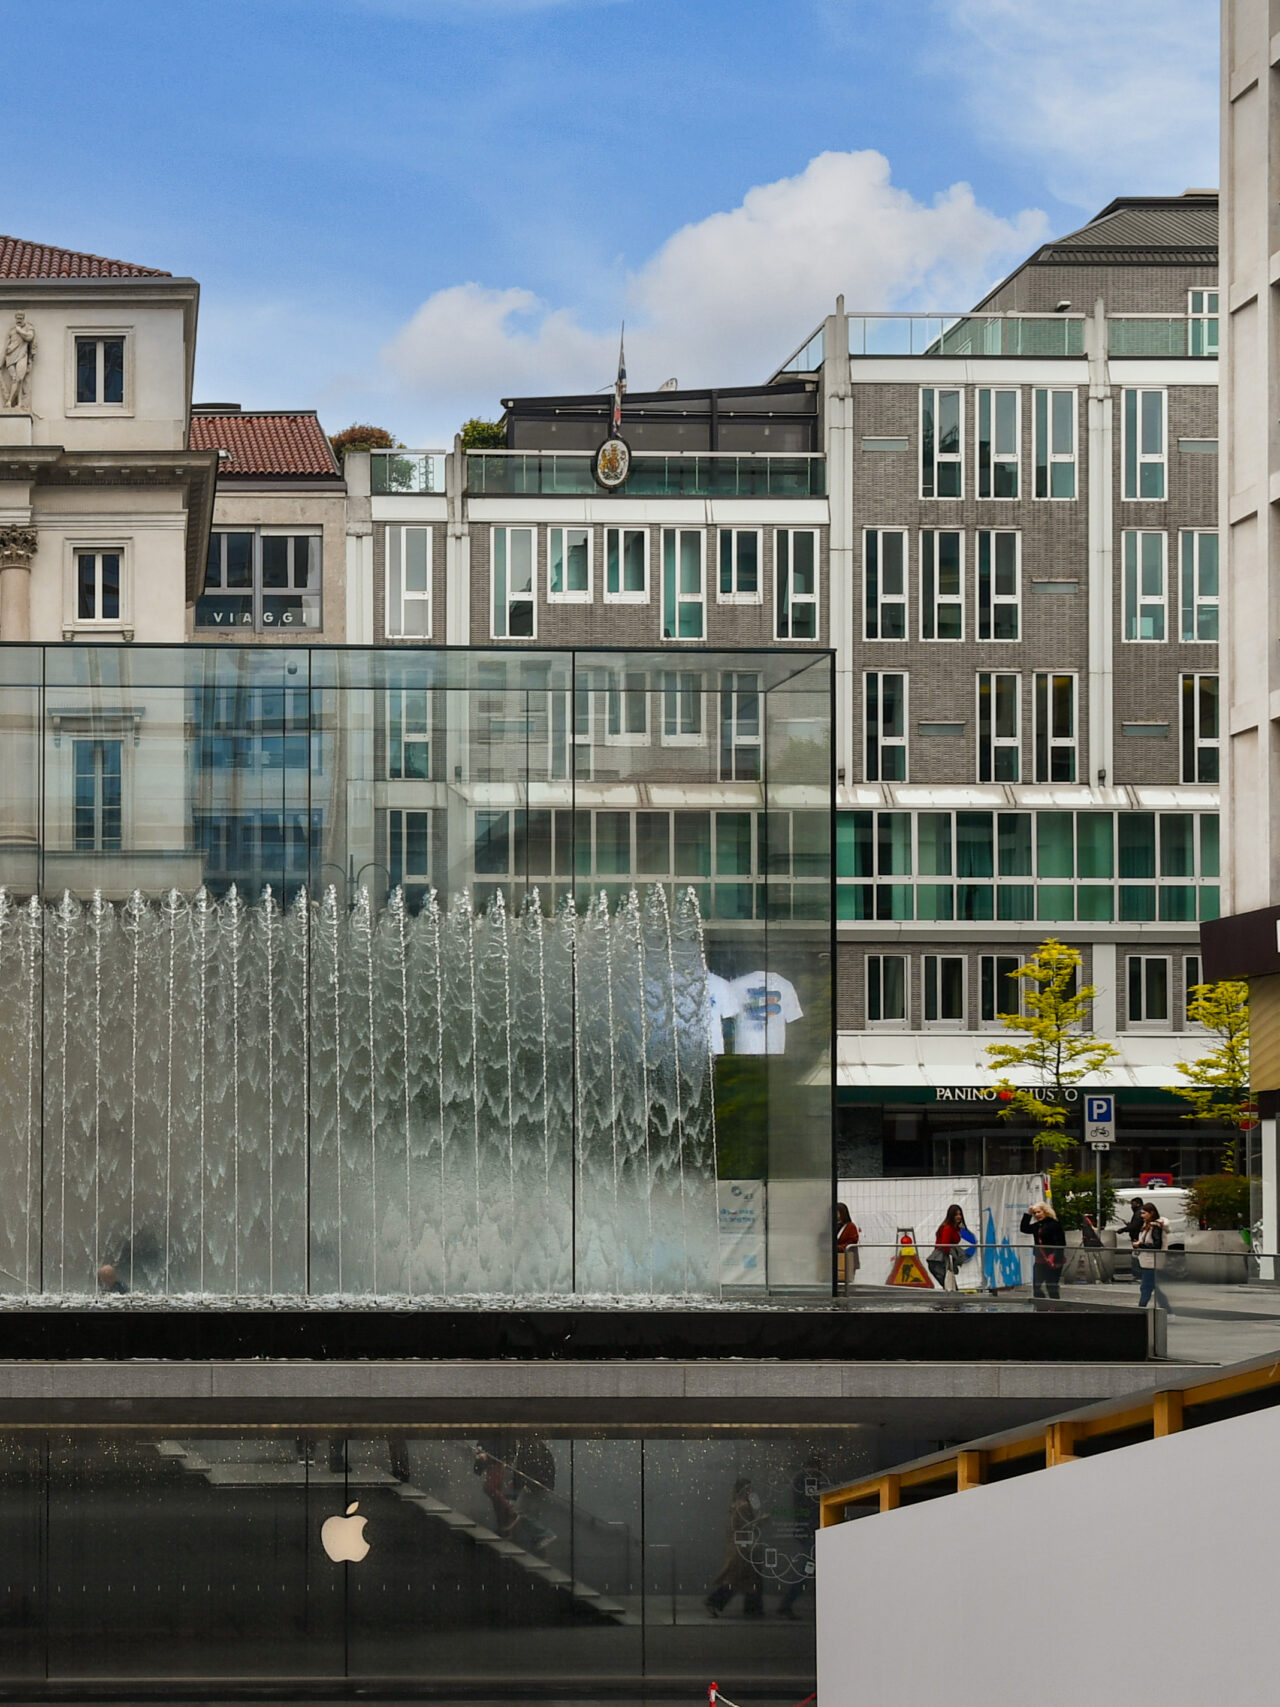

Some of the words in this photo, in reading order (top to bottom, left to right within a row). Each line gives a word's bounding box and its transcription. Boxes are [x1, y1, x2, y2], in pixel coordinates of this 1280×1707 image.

[213, 612, 306, 623] VIAGGI
[936, 1088, 997, 1101] PANINO
[1017, 1088, 1078, 1102] USO
[1093, 1100, 1107, 1120] P
